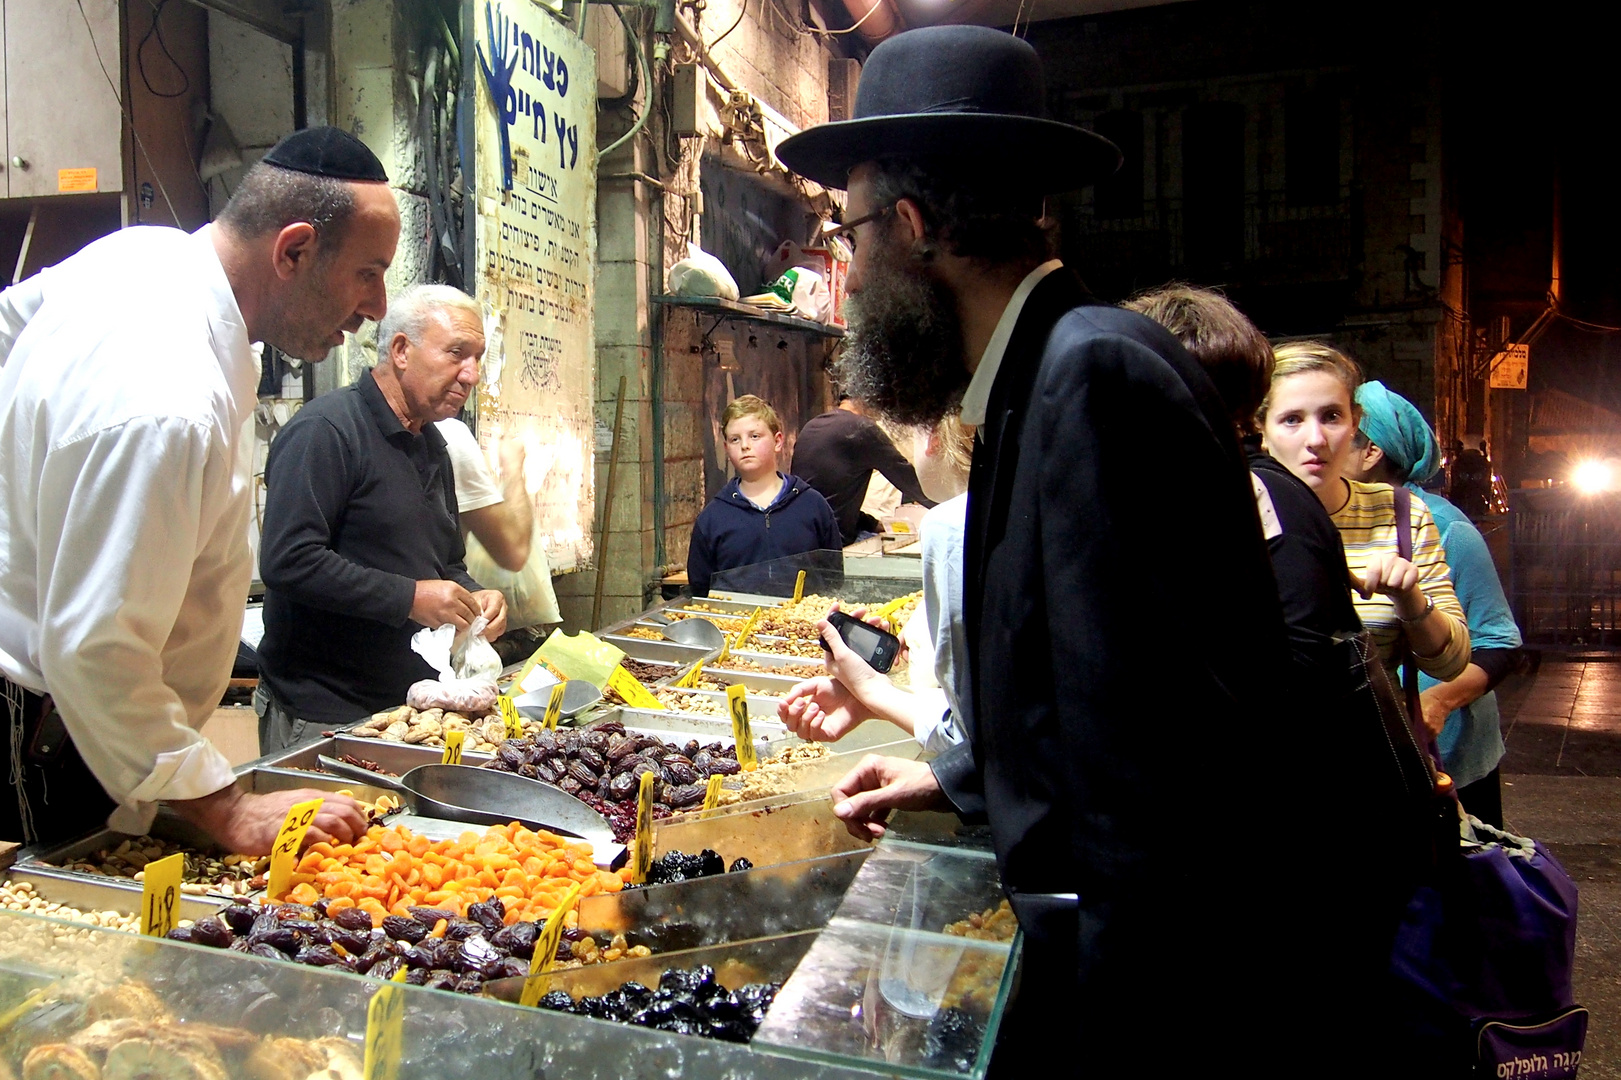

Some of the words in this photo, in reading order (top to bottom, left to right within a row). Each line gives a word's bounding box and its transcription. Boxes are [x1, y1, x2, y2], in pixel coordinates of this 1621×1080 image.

[513, 22, 568, 97] פצוחי
[506, 84, 546, 144] חיים
[554, 111, 577, 170] עץ
[511, 193, 526, 215] בזה
[531, 202, 564, 232] מאשרים
[567, 219, 579, 239] אנו
[507, 290, 534, 313] בחנות
[281, 809, 315, 836] 20
[148, 886, 174, 938] 48
[1554, 1050, 1582, 1073] מגה
